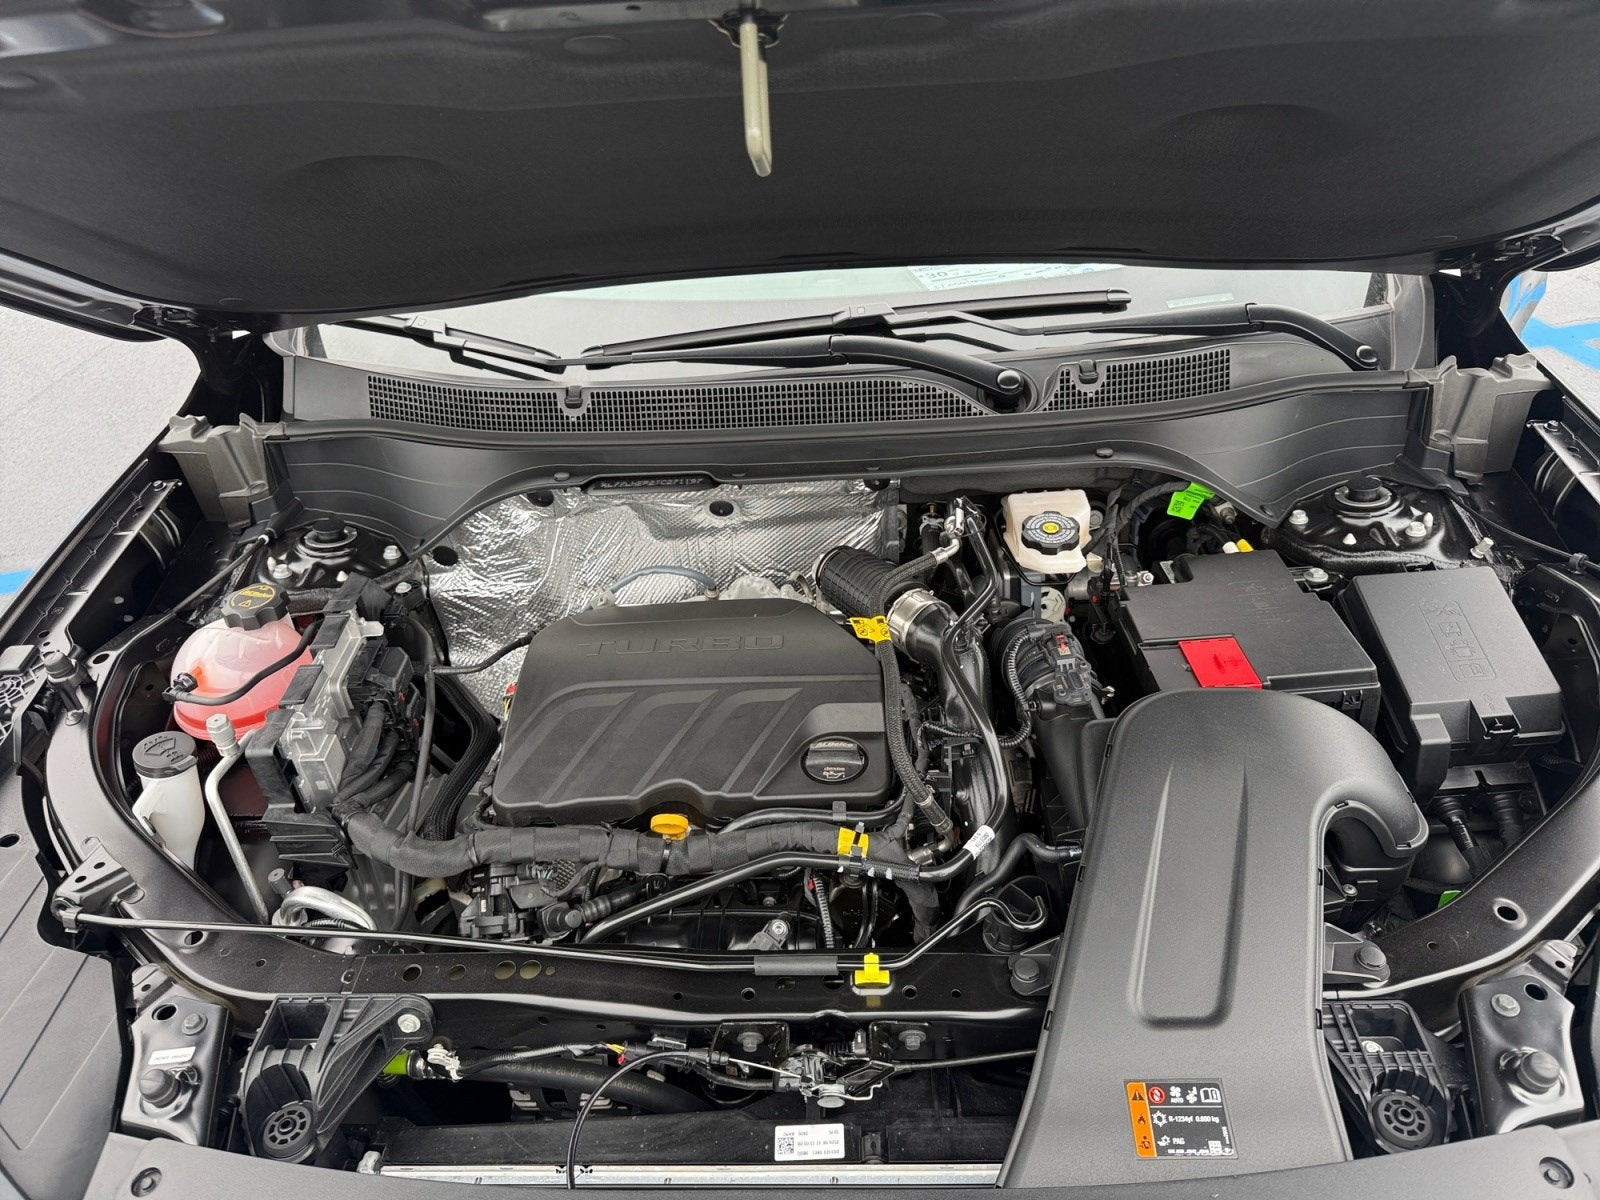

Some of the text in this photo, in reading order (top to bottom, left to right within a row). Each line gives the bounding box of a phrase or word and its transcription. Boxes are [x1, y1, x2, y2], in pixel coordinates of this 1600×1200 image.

[577, 634, 785, 657] TURBO
[1211, 1115, 1220, 1124] kg
[1172, 1137, 1186, 1145] PAG
